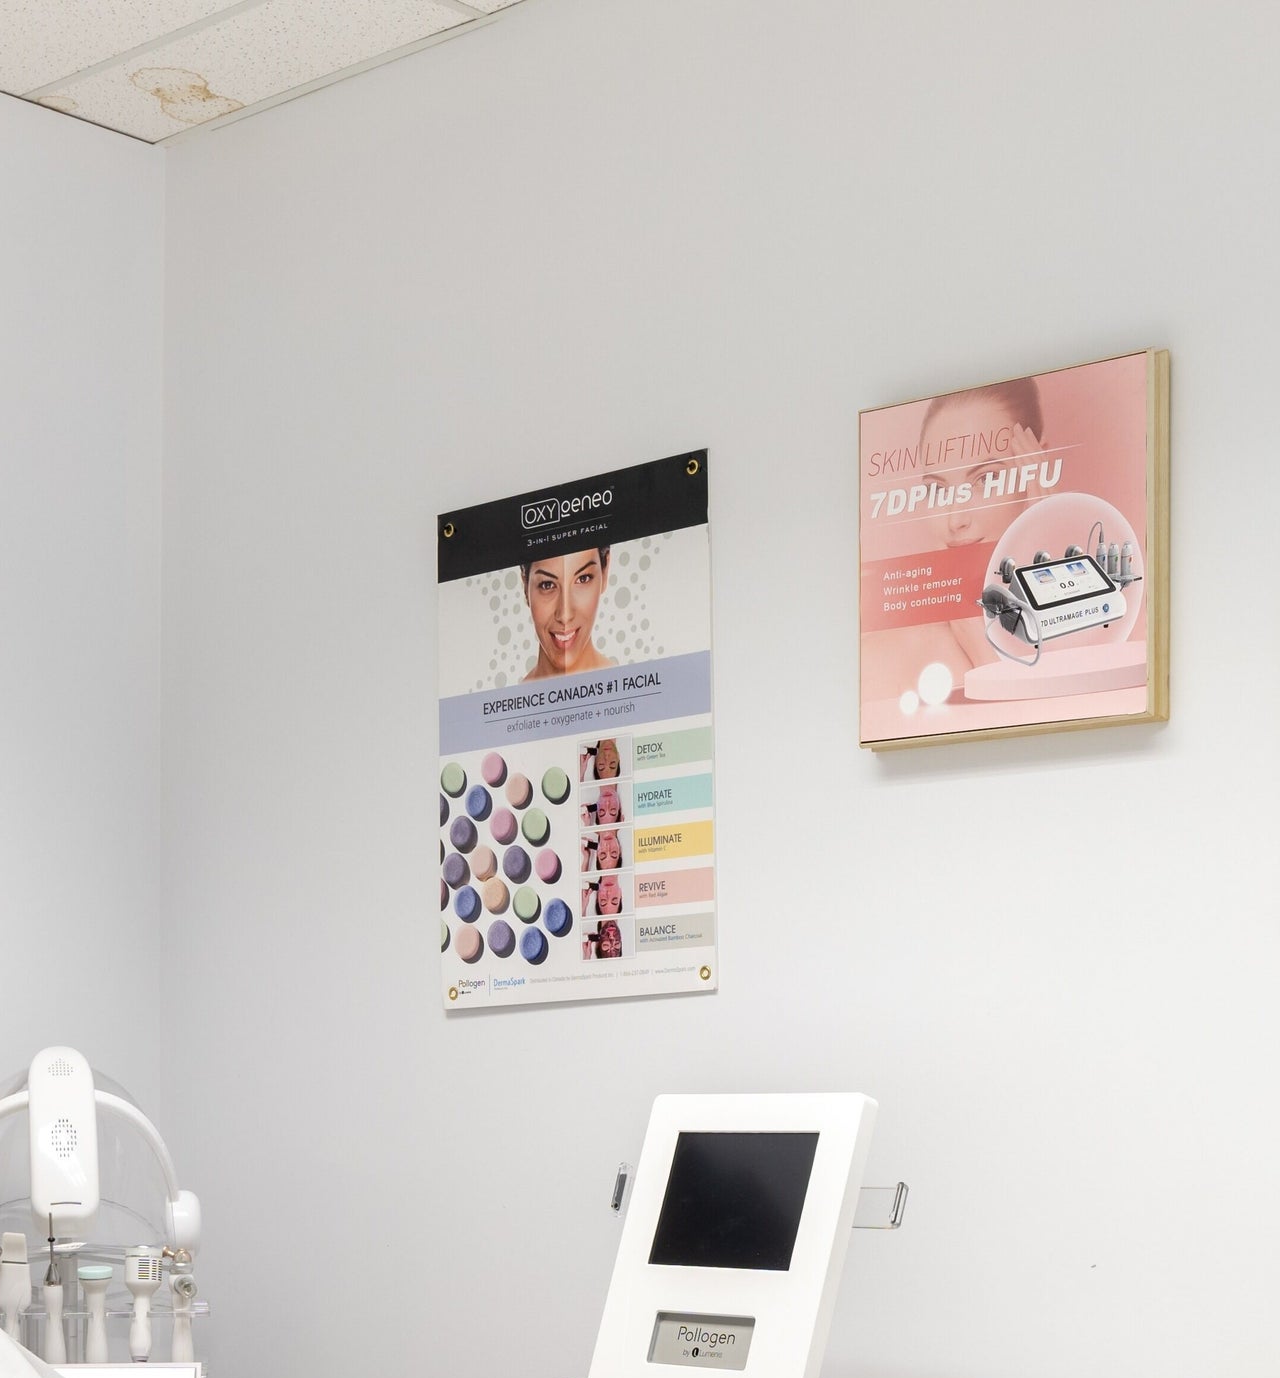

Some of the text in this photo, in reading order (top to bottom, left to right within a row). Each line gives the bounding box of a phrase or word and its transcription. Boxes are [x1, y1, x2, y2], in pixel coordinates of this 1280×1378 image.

[869, 426, 1011, 478] SKIN LIFTING
[870, 459, 1063, 519] 7DPlus HIFU
[552, 530, 577, 541] SUPER
[580, 523, 608, 534] FACIAL
[883, 567, 932, 581] Anti-aging
[883, 577, 962, 596] Wrinkle remover
[883, 593, 962, 612] Body contouring
[1084, 606, 1099, 617] PLUS
[483, 672, 661, 715] EXPERIENCE CANADA'S #1 FACIAL
[507, 717, 540, 733] exfoliate
[551, 709, 593, 726] oxygenate
[604, 701, 635, 717] nourish
[637, 742, 663, 755] DETOX
[637, 789, 672, 802] HYDRATE
[638, 833, 682, 847] ILLUMINATE
[639, 880, 666, 892] REVIVE
[640, 924, 676, 936] BALANCE
[459, 979, 485, 989] Pollogen
[677, 1325, 736, 1348] Pollogen
[682, 1349, 690, 1357] by
